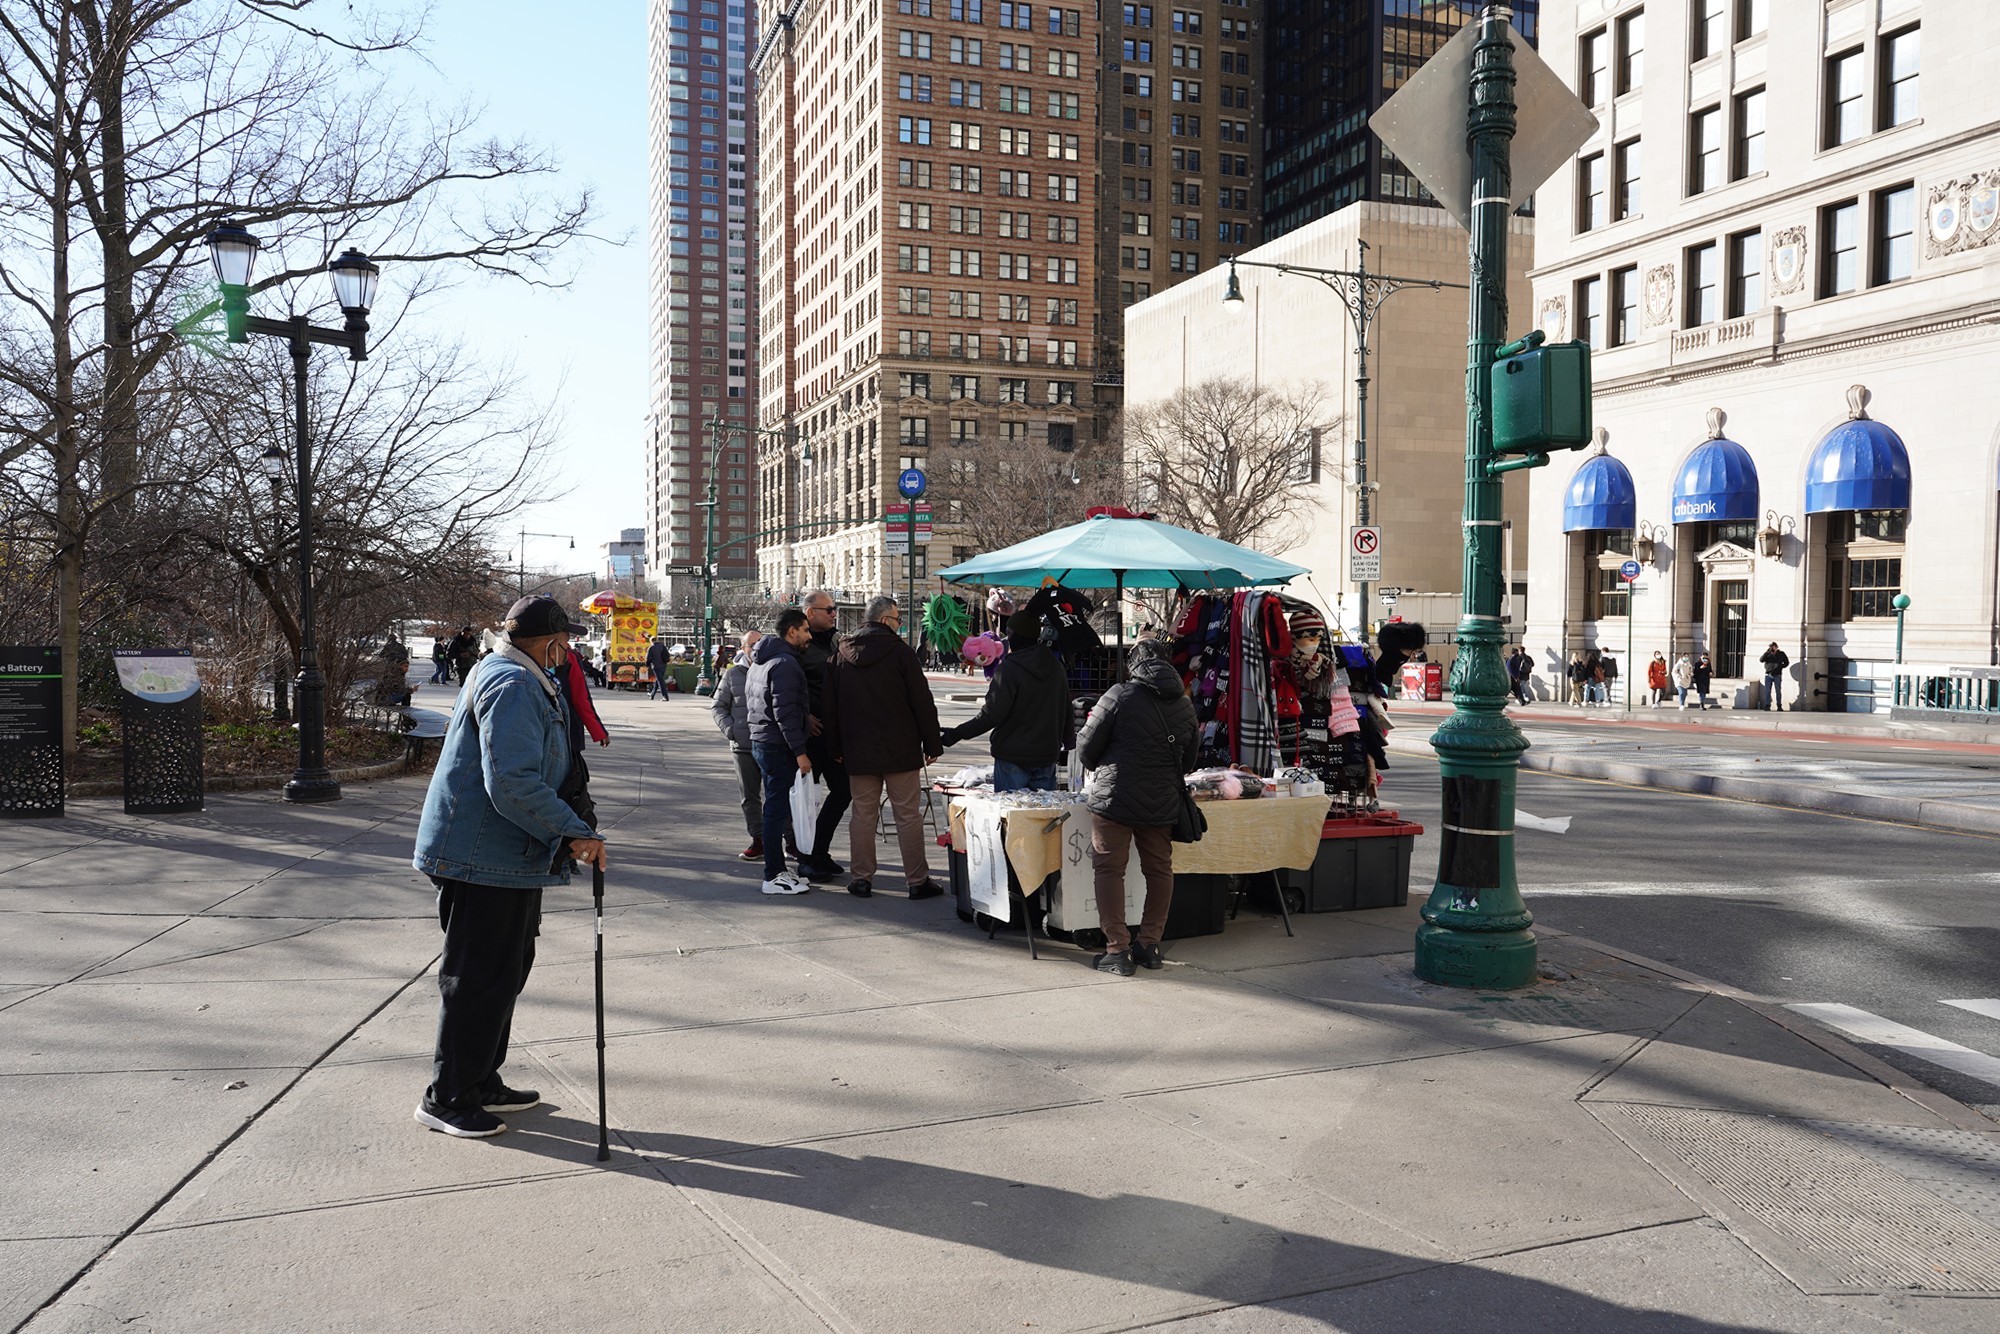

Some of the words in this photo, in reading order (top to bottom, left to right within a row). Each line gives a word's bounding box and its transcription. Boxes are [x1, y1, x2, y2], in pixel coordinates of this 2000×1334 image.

[1674, 499, 1716, 516] citibank
[668, 566, 689, 574] Greenwich
[1053, 603, 1065, 616] I
[7, 664, 43, 674] Battery
